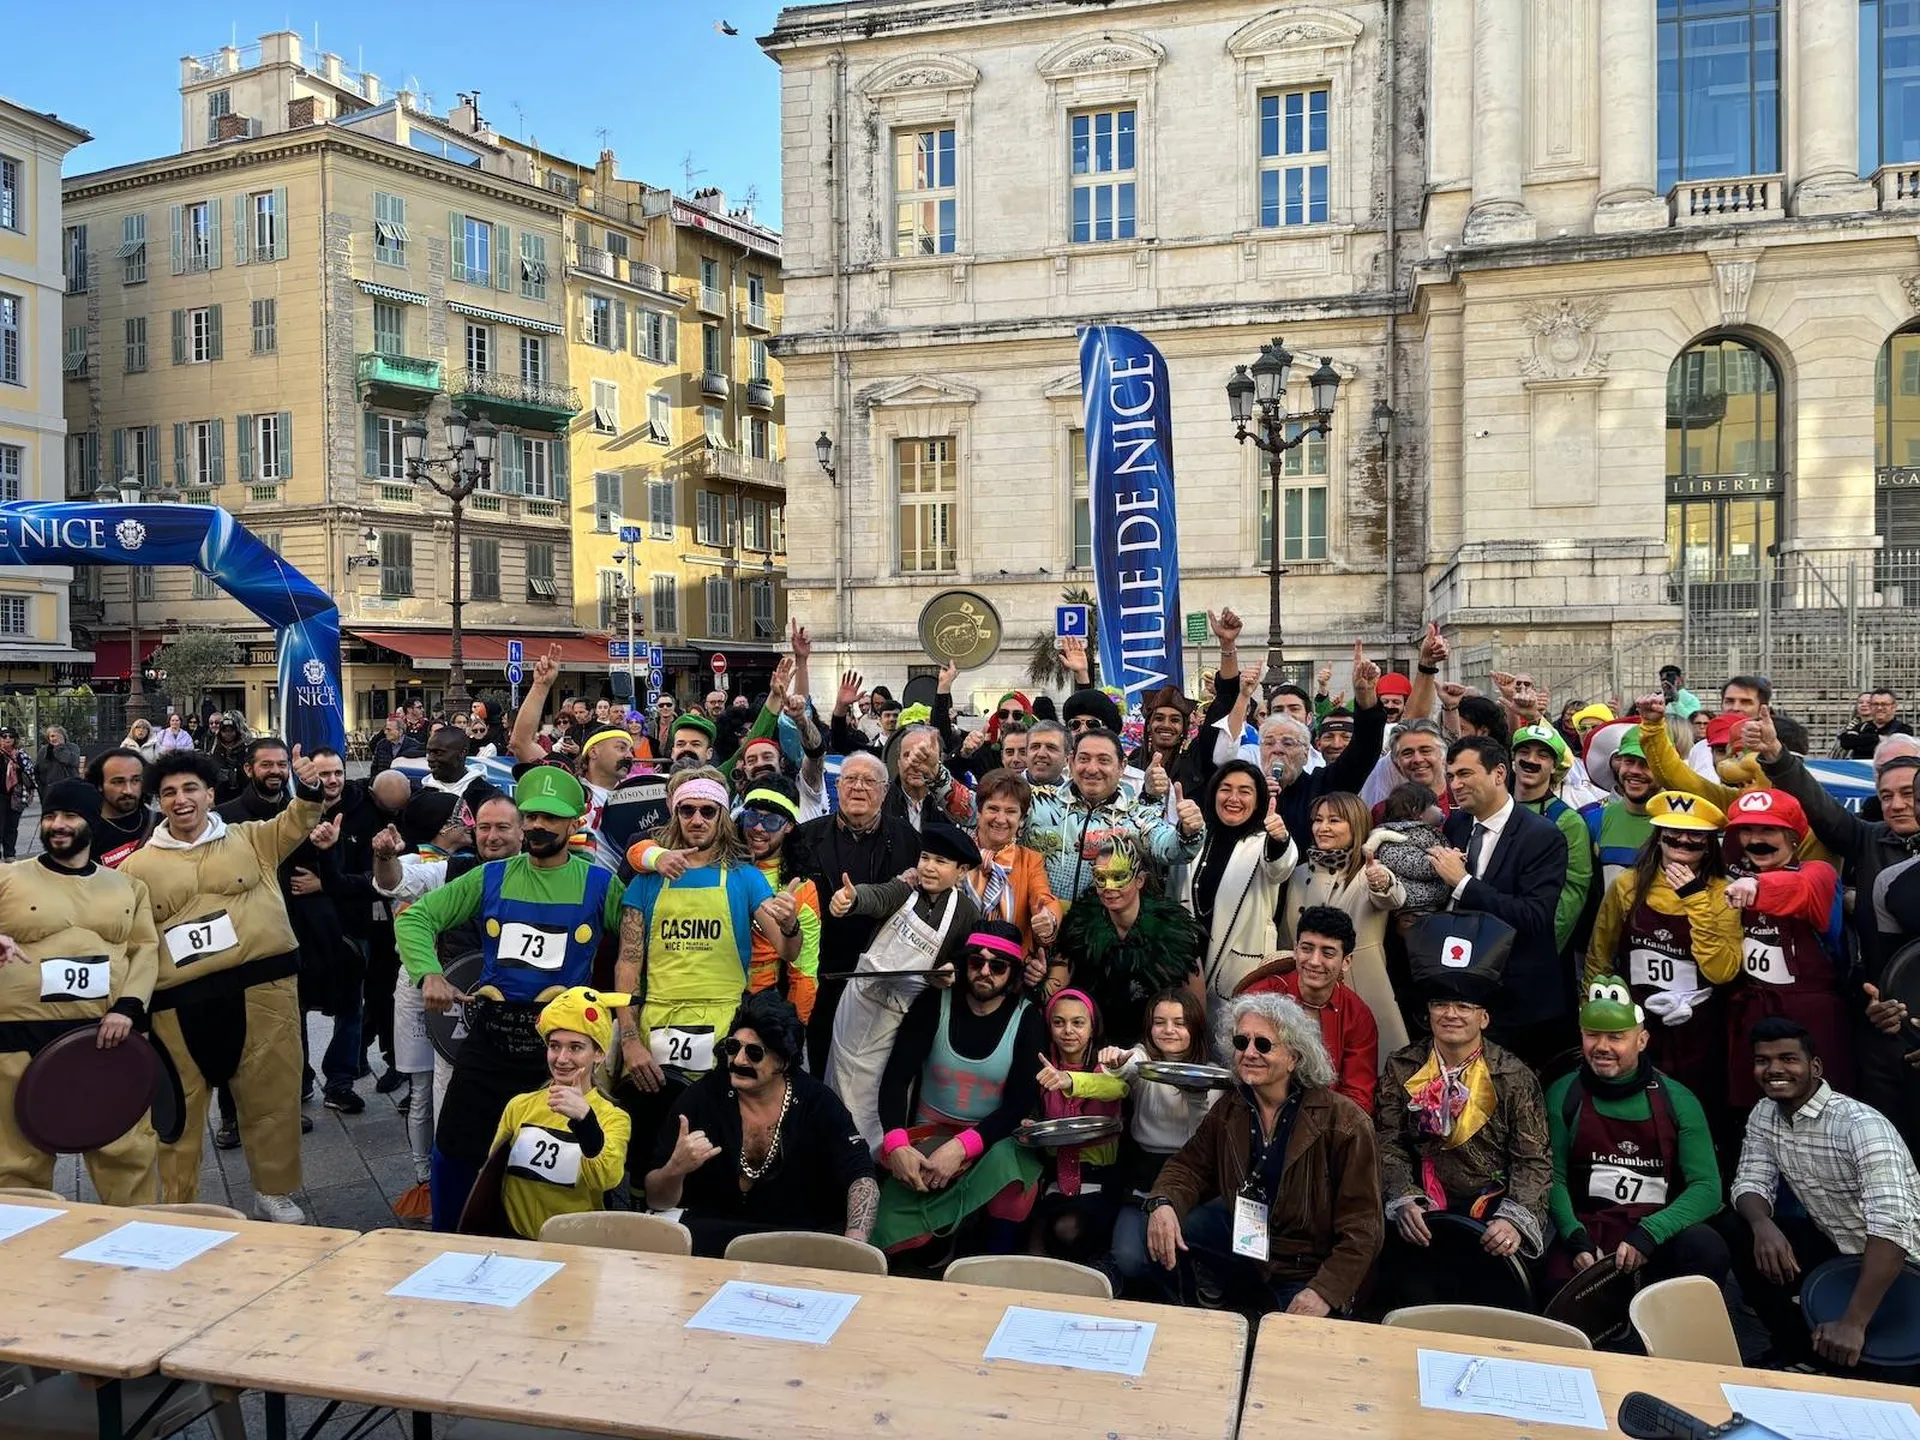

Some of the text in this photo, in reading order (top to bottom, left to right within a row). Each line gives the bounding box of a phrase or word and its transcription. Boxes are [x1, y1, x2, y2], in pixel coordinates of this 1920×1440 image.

[20, 518, 107, 549] NICE
[1110, 353, 1168, 694] VILLE DE NICE
[1064, 612, 1078, 631] P
[296, 685, 334, 695] VILLE DE
[298, 693, 335, 706] NICE
[1534, 728, 1545, 736] L
[542, 775, 557, 796] L
[1666, 794, 1695, 812] W
[1743, 795, 1768, 807] M
[639, 808, 660, 830] 1664
[188, 925, 212, 950] 87
[661, 919, 722, 940] CASINO
[1630, 935, 1642, 945] Le
[520, 933, 545, 958] 73
[664, 942, 681, 951] NICE
[1648, 959, 1674, 982] 50
[1747, 948, 1770, 973] 66
[64, 967, 90, 990] 98
[669, 1037, 692, 1061] 26
[530, 1140, 560, 1170] 23
[1592, 1151, 1607, 1162] Le
[1615, 1175, 1643, 1202] 67
